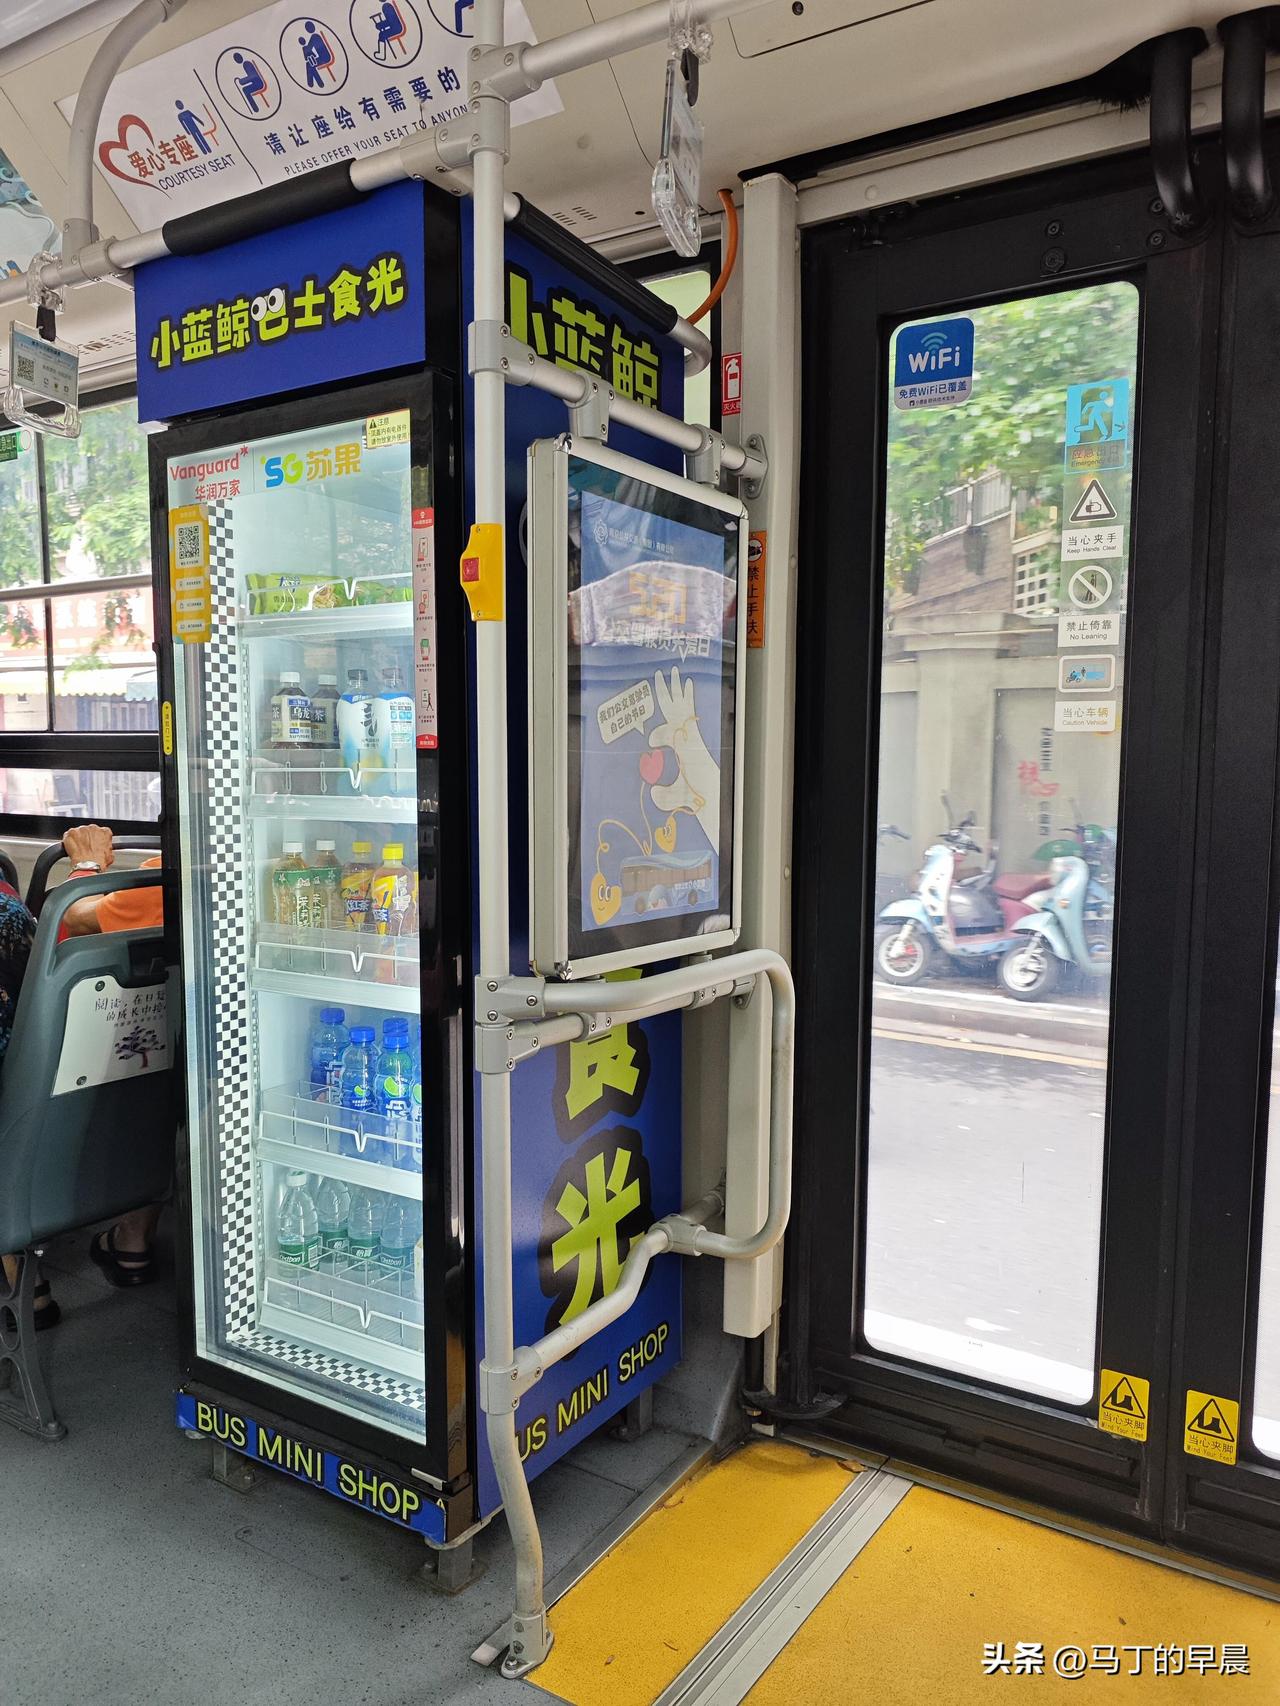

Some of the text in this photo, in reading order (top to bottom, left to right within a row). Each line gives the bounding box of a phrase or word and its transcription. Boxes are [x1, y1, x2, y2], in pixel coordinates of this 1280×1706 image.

[264, 66, 461, 156] 请让座给有需要的
[284, 156, 319, 176] PLEASE
[322, 145, 353, 164] OFFER
[353, 135, 382, 152] YOUR
[385, 125, 410, 142] SEAT
[431, 104, 468, 126] ANYON
[127, 134, 199, 178] 爱心专座
[158, 154, 236, 190] COURTESY SEAT
[150, 257, 404, 368] 小蓝鲸巴士食光
[908, 345, 961, 374] WiFi
[899, 380, 967, 399] 免费WiFi已覆盖
[170, 453, 241, 482] Vanguard
[305, 442, 361, 482] 苏果
[195, 479, 240, 501] 华润万家
[1068, 532, 1117, 546] 当心夹手
[1066, 619, 1112, 631] 禁止倚靠
[610, 704, 646, 734] 自己的节日
[1063, 707, 1109, 718] 当心车辆
[514, 1323, 669, 1462] US MINI SHOP
[1101, 1421, 1115, 1431] Mind
[1116, 1425, 1129, 1435] Your
[1103, 1411, 1145, 1431] 当心夹脚
[1187, 1445, 1200, 1454] Mind
[1203, 1448, 1217, 1458] Your
[1188, 1434, 1234, 1455] 当心夹脚
[196, 1401, 420, 1520] BUS MINI SHOP
